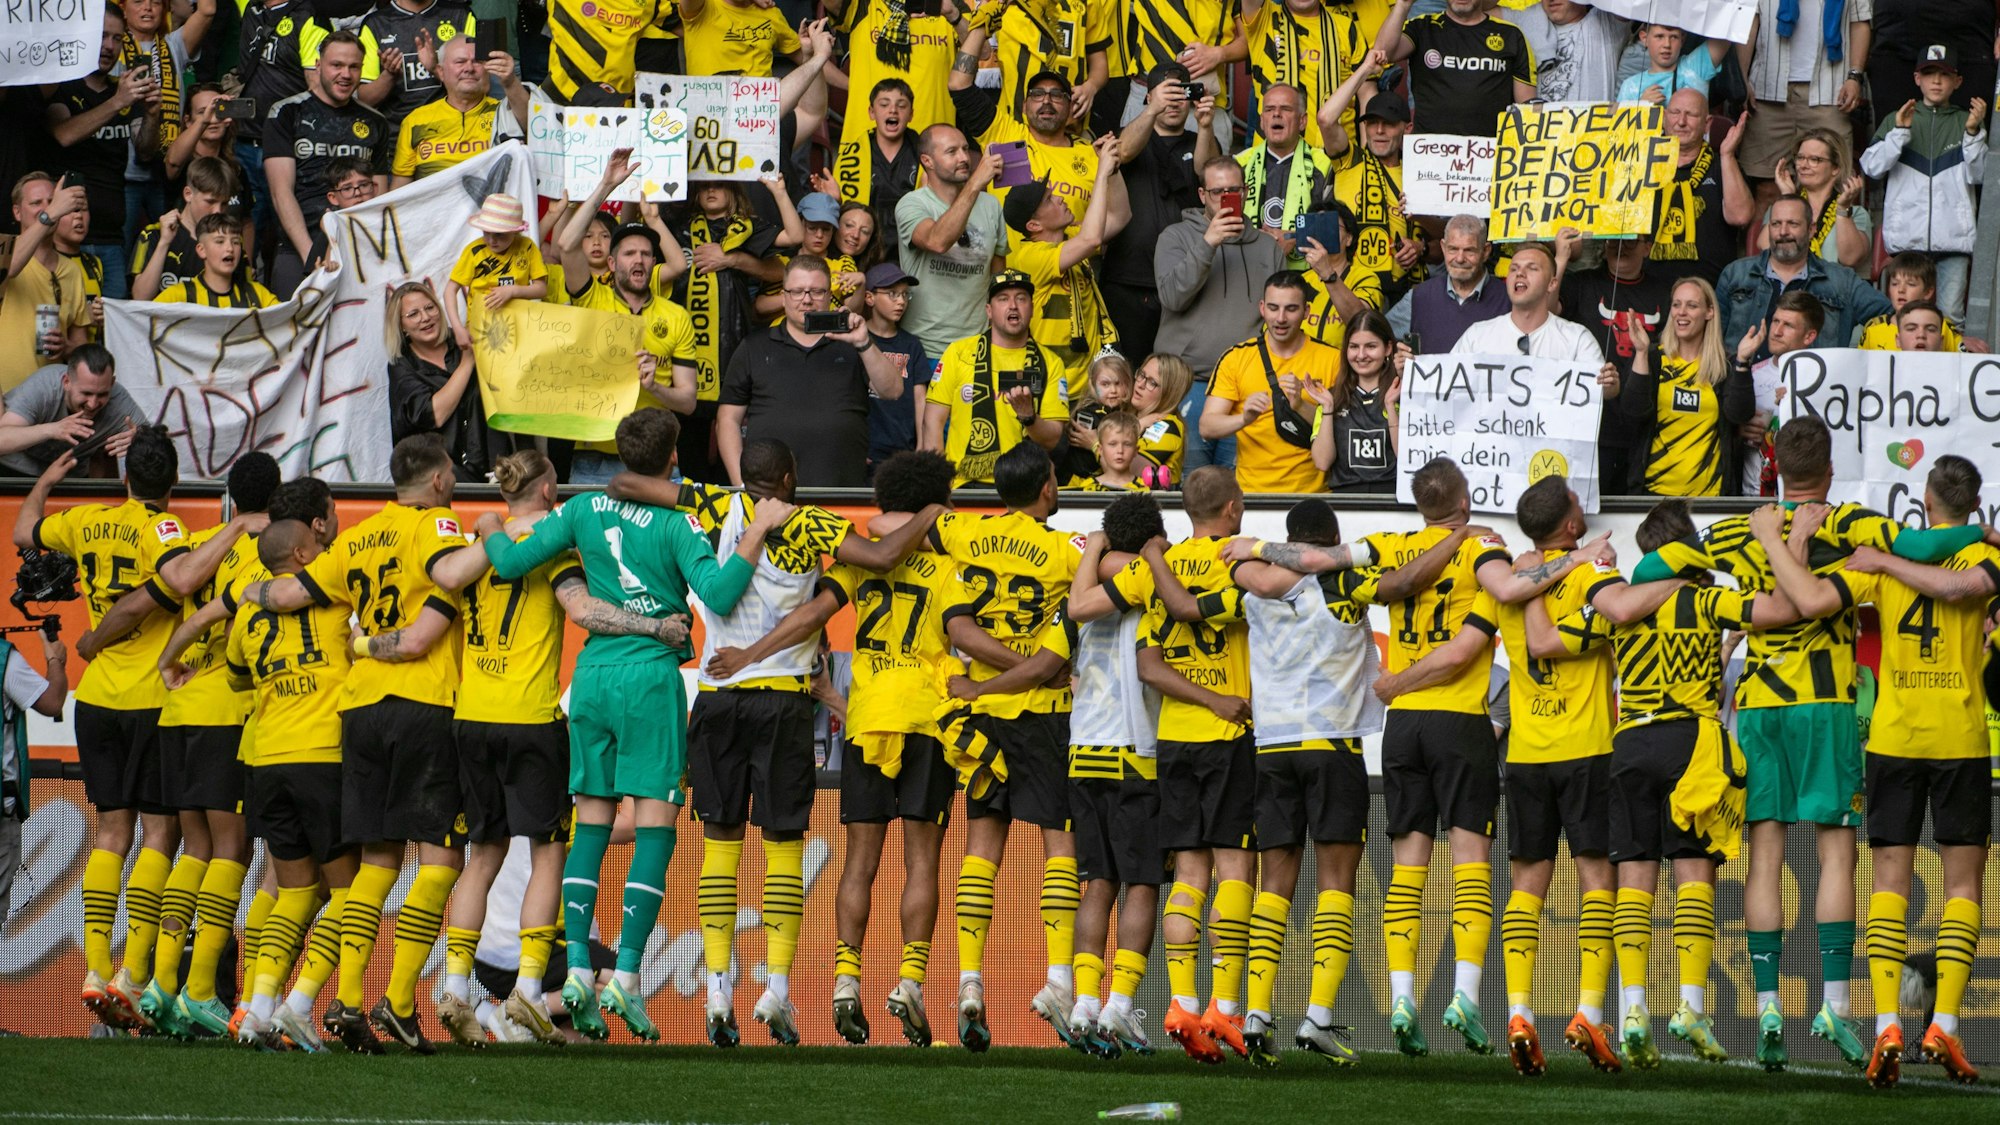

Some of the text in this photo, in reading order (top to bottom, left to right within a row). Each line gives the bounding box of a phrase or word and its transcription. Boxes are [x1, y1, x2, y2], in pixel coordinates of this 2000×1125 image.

[440, 26, 455, 37] BVB
[597, 9, 642, 29] EVONIK
[910, 33, 949, 47] ONIK
[406, 62, 435, 81] 1&
[1443, 56, 1507, 73] EVONIK
[731, 81, 780, 103] Trikot
[651, 109, 684, 135] BVB
[706, 103, 777, 119] darf ich dein
[92, 125, 131, 140] VONI
[694, 115, 720, 140] 09
[434, 141, 491, 154] EVONI
[687, 140, 737, 175] BV
[1413, 138, 1463, 158] Gregor
[532, 151, 683, 178] TRIOT
[840, 141, 861, 200] ORUS
[1495, 136, 1672, 188] BEKOMME
[1689, 151, 1713, 190] MEINE
[1416, 170, 1442, 181] bitte
[1439, 183, 1492, 204] Trikot
[1494, 171, 1643, 210] ICH DEIN
[1501, 198, 1600, 238] TRIKOT
[1360, 231, 1388, 256] BVB
[929, 259, 985, 276] SUNDOWNER
[1367, 255, 1379, 265] 09
[526, 307, 572, 334] Marco
[552, 335, 594, 359] Reus
[517, 356, 541, 374] Ich
[577, 364, 620, 383] Dein
[696, 361, 715, 384] VB
[1408, 361, 1597, 408] MATS 15
[1675, 389, 1698, 407] 1&1
[1780, 351, 1950, 455] Rapha
[970, 422, 991, 441] BVB
[1407, 409, 1547, 437] bitte schenk
[1352, 438, 1382, 459] 1&1
[1461, 441, 1511, 468] dein
[1533, 455, 1563, 480] BVB
[603, 525, 648, 595] 1
[969, 535, 1049, 569] DORTMUND
[81, 551, 140, 616] 15
[462, 574, 529, 651] 17
[622, 596, 662, 616] OBEL
[963, 564, 1050, 639] 23
[1398, 577, 1456, 651] 11
[855, 578, 934, 660] 27
[1897, 592, 1944, 664] 4
[246, 603, 329, 680] 21
[1008, 640, 1033, 658] CAN
[476, 655, 509, 675] WOLF
[274, 675, 318, 699] MALEN
[1531, 693, 1567, 717] ÖZCAN
